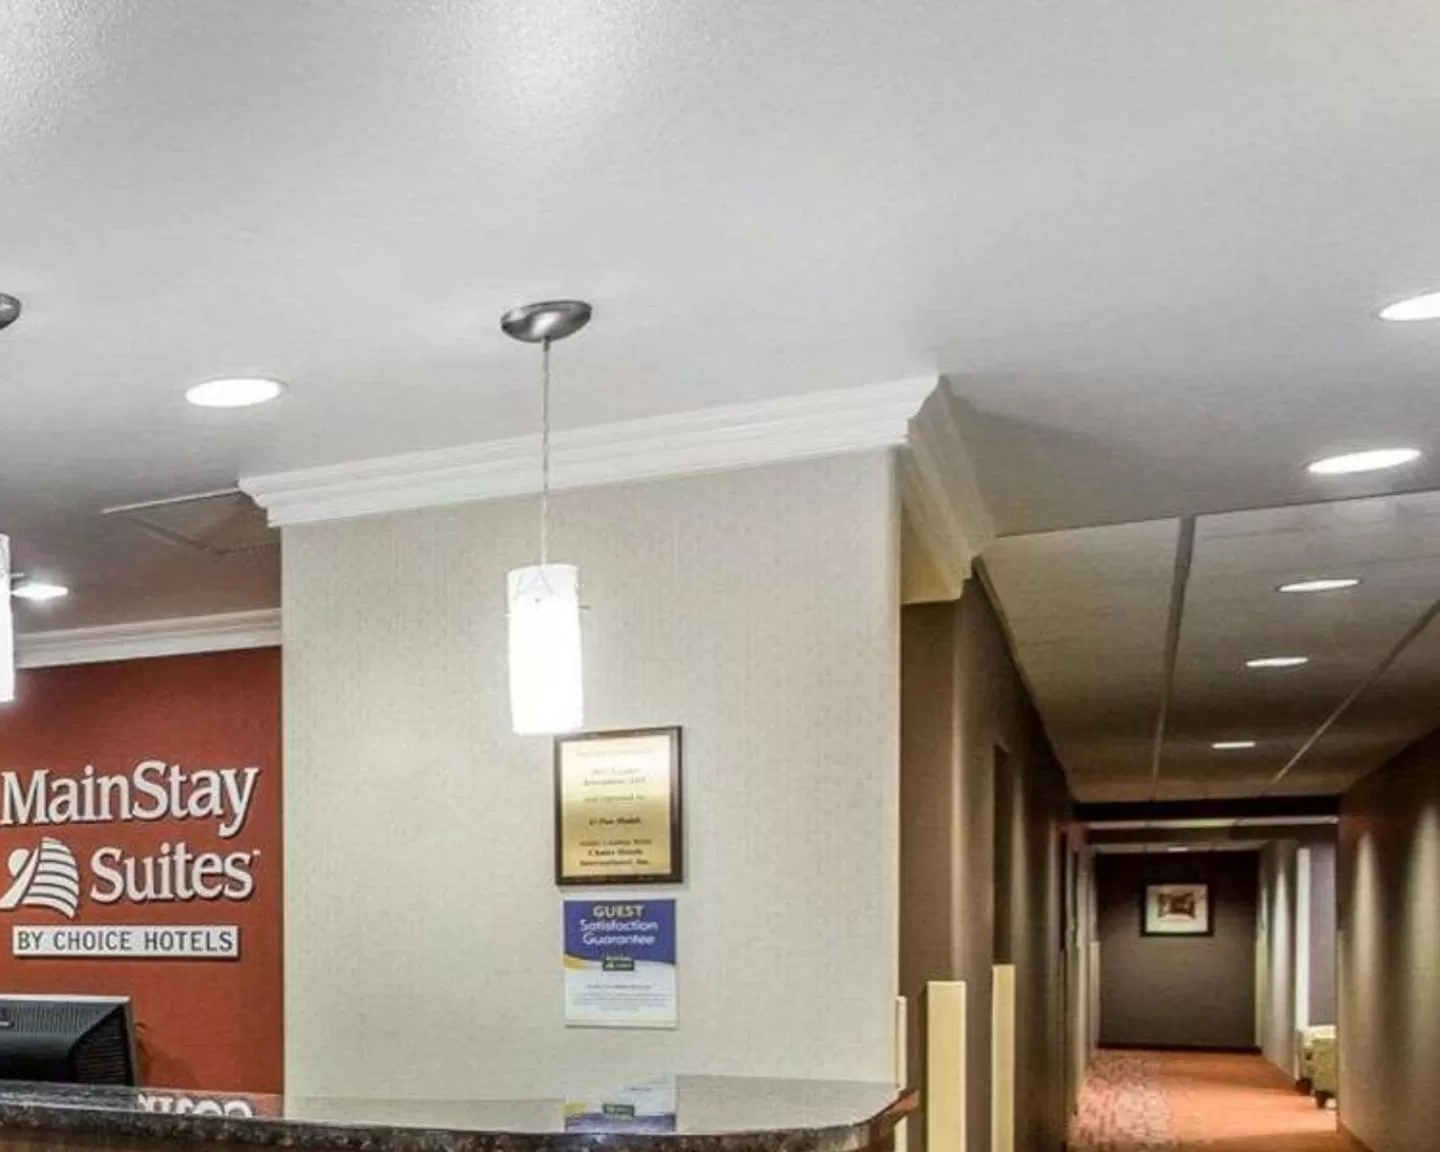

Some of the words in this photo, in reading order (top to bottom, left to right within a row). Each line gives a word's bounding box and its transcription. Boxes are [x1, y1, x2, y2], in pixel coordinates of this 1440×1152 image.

[0, 760, 259, 837] MainStay
[90, 842, 254, 903] Suites
[592, 905, 644, 918] GUEST
[579, 919, 659, 932] Satisfaction
[17, 931, 45, 951] BY
[53, 931, 131, 951] CHOICE
[144, 931, 234, 952] HOTELS
[582, 932, 656, 945] Guarantee
